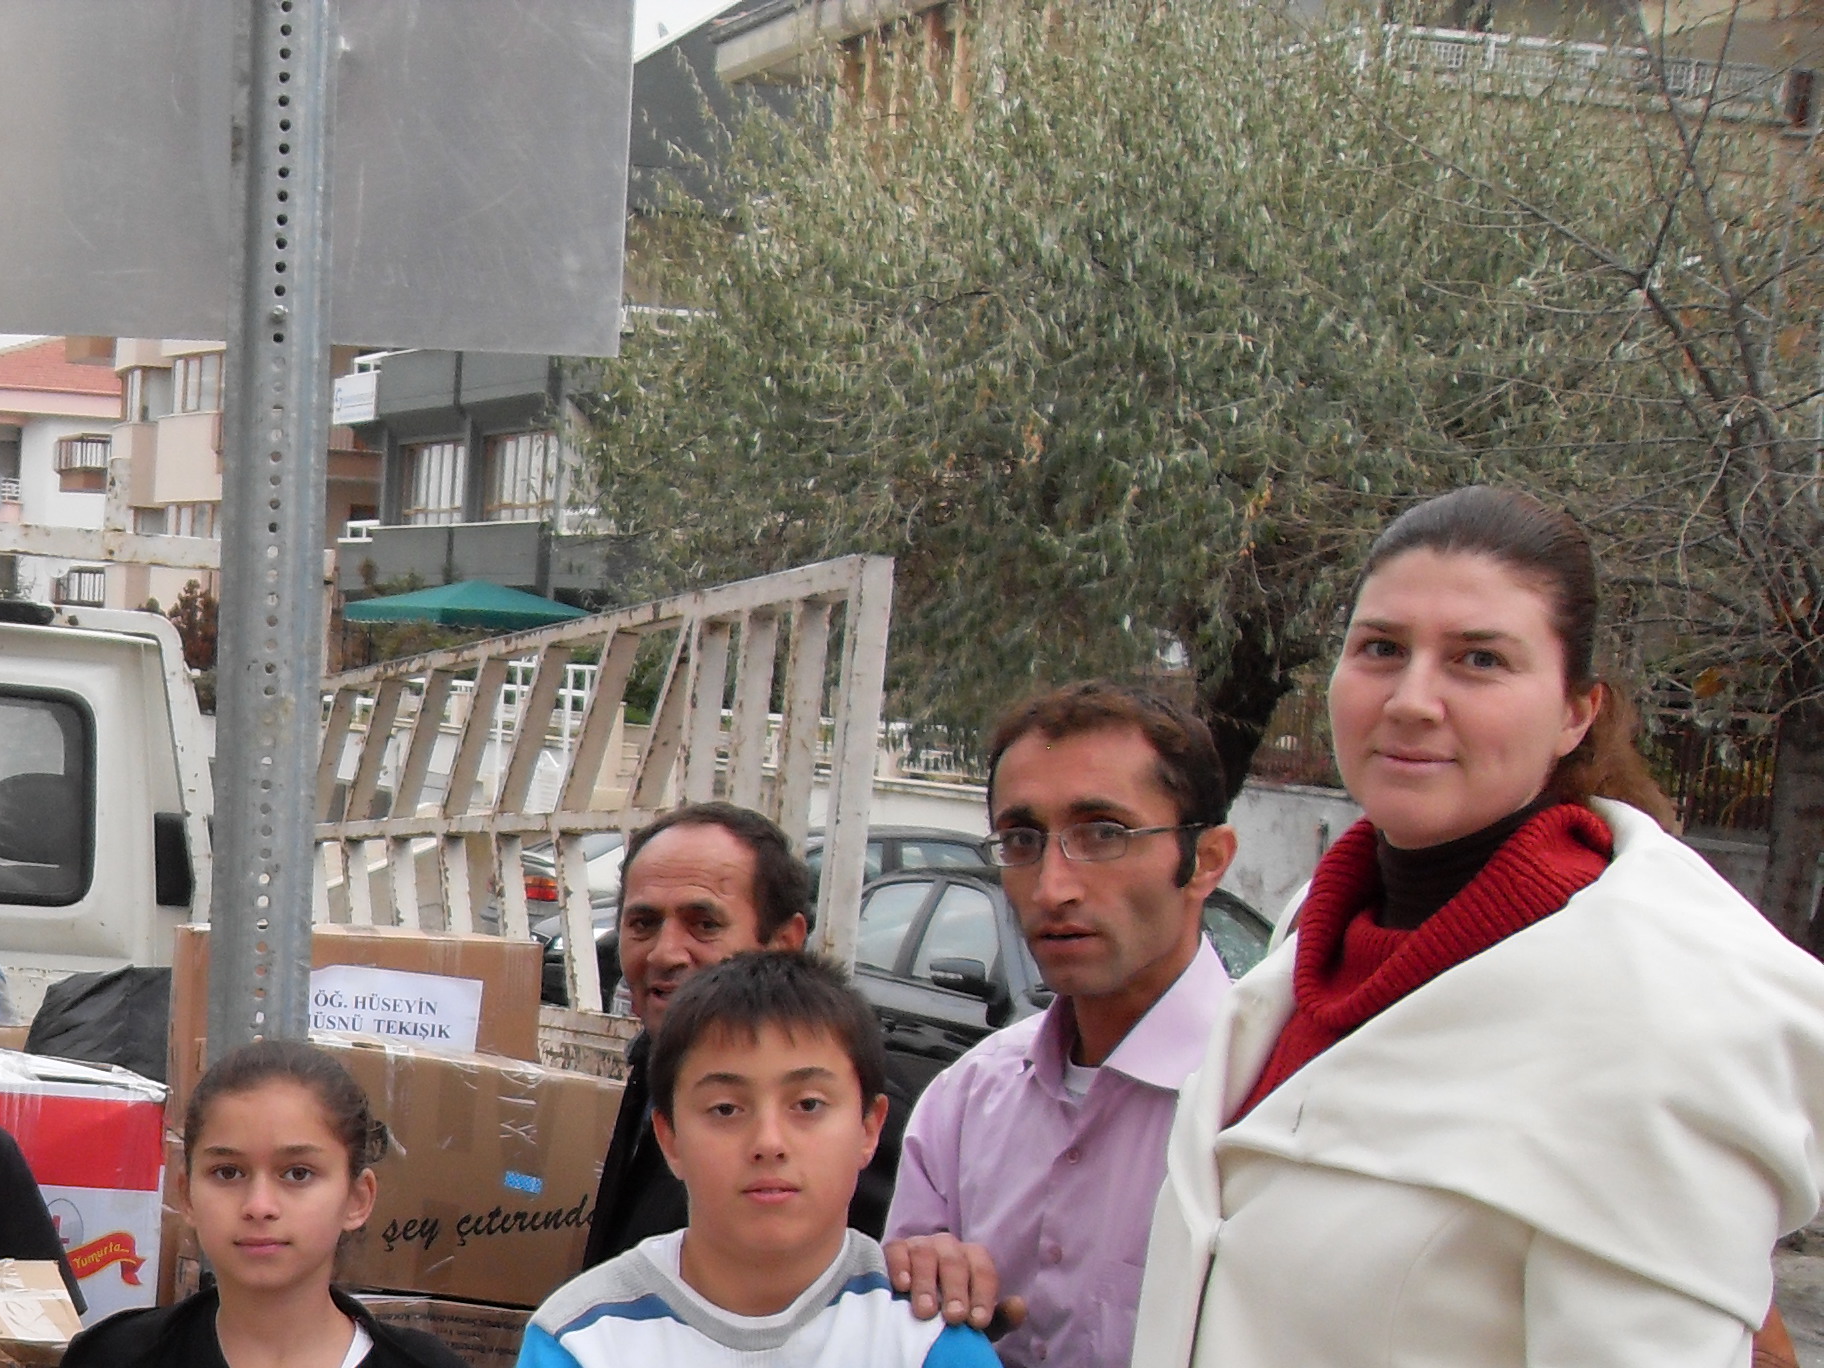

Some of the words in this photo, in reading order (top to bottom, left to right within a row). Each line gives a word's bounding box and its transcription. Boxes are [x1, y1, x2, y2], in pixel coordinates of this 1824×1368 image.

[314, 988, 348, 1009] ÖĞ.
[353, 993, 438, 1016] HÜSEYİN
[373, 1018, 451, 1041] TEKIŞIK
[381, 1216, 439, 1252] şey
